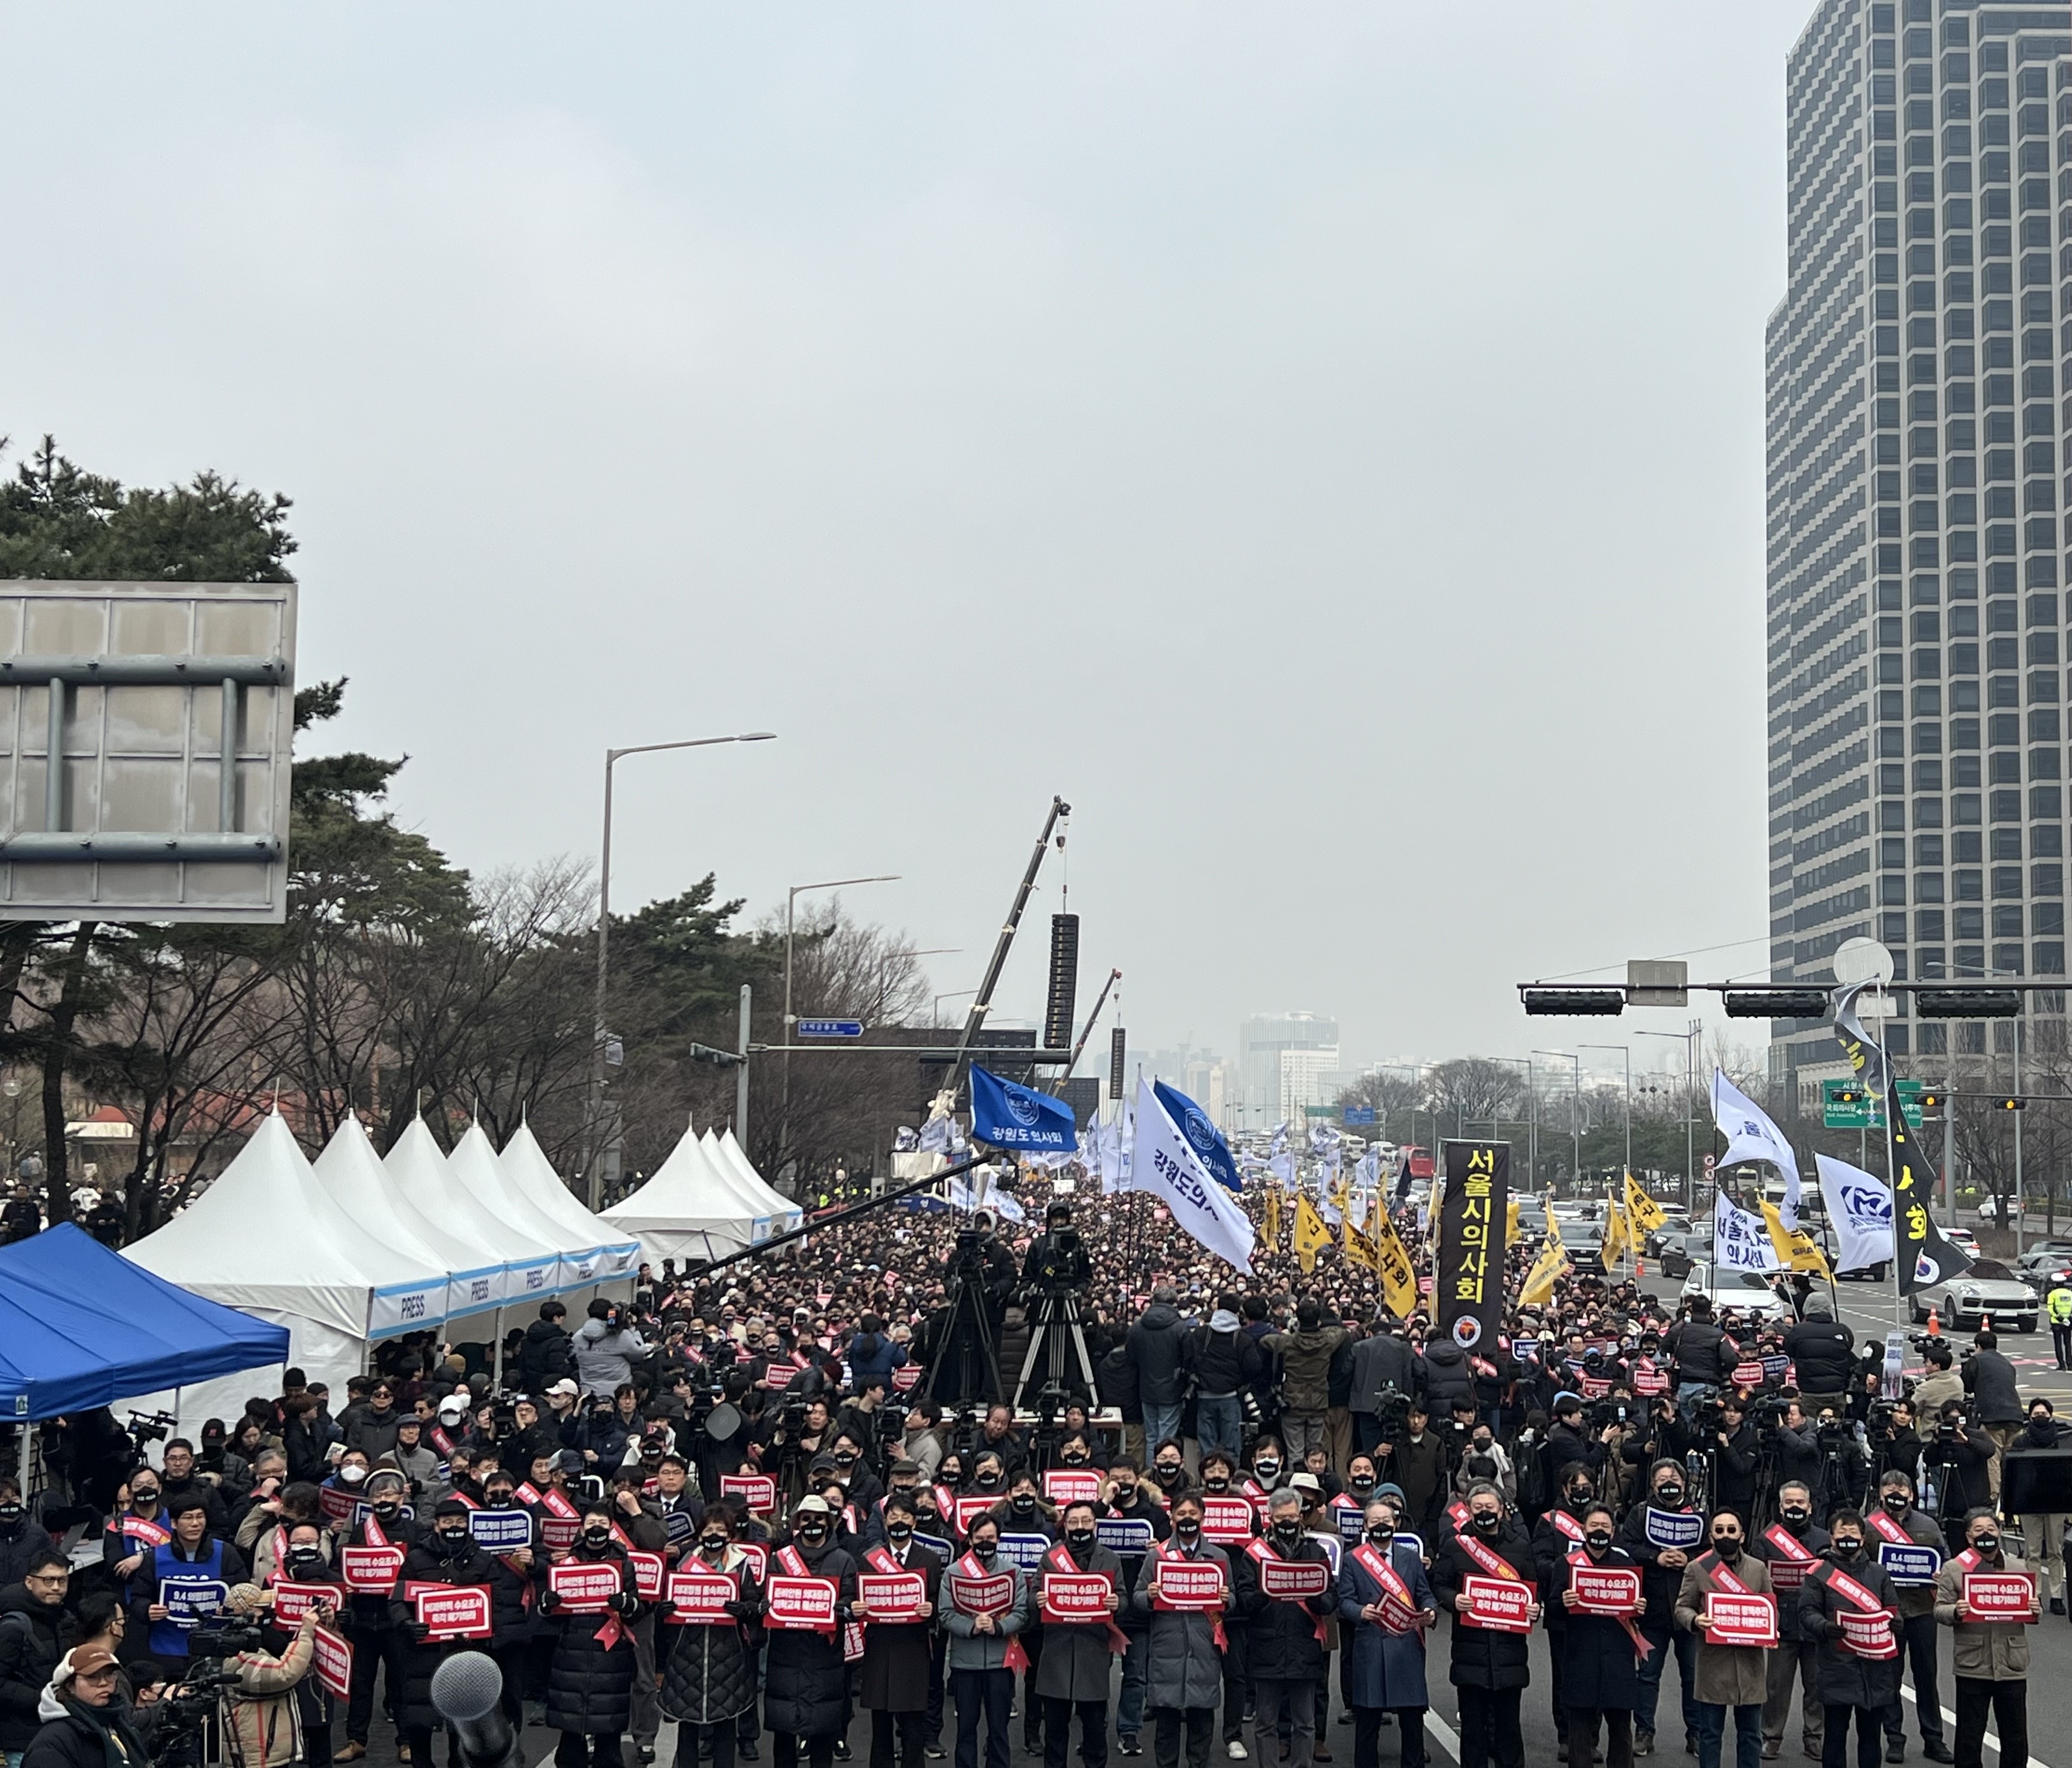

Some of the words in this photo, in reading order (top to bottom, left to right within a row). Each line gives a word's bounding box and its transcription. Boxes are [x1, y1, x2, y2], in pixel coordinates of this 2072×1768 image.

[1455, 1149, 1494, 1304] 서울시의사회
[471, 1279, 489, 1301] PRESS
[527, 1270, 543, 1290] PRESS
[401, 1294, 426, 1320] PRESS
